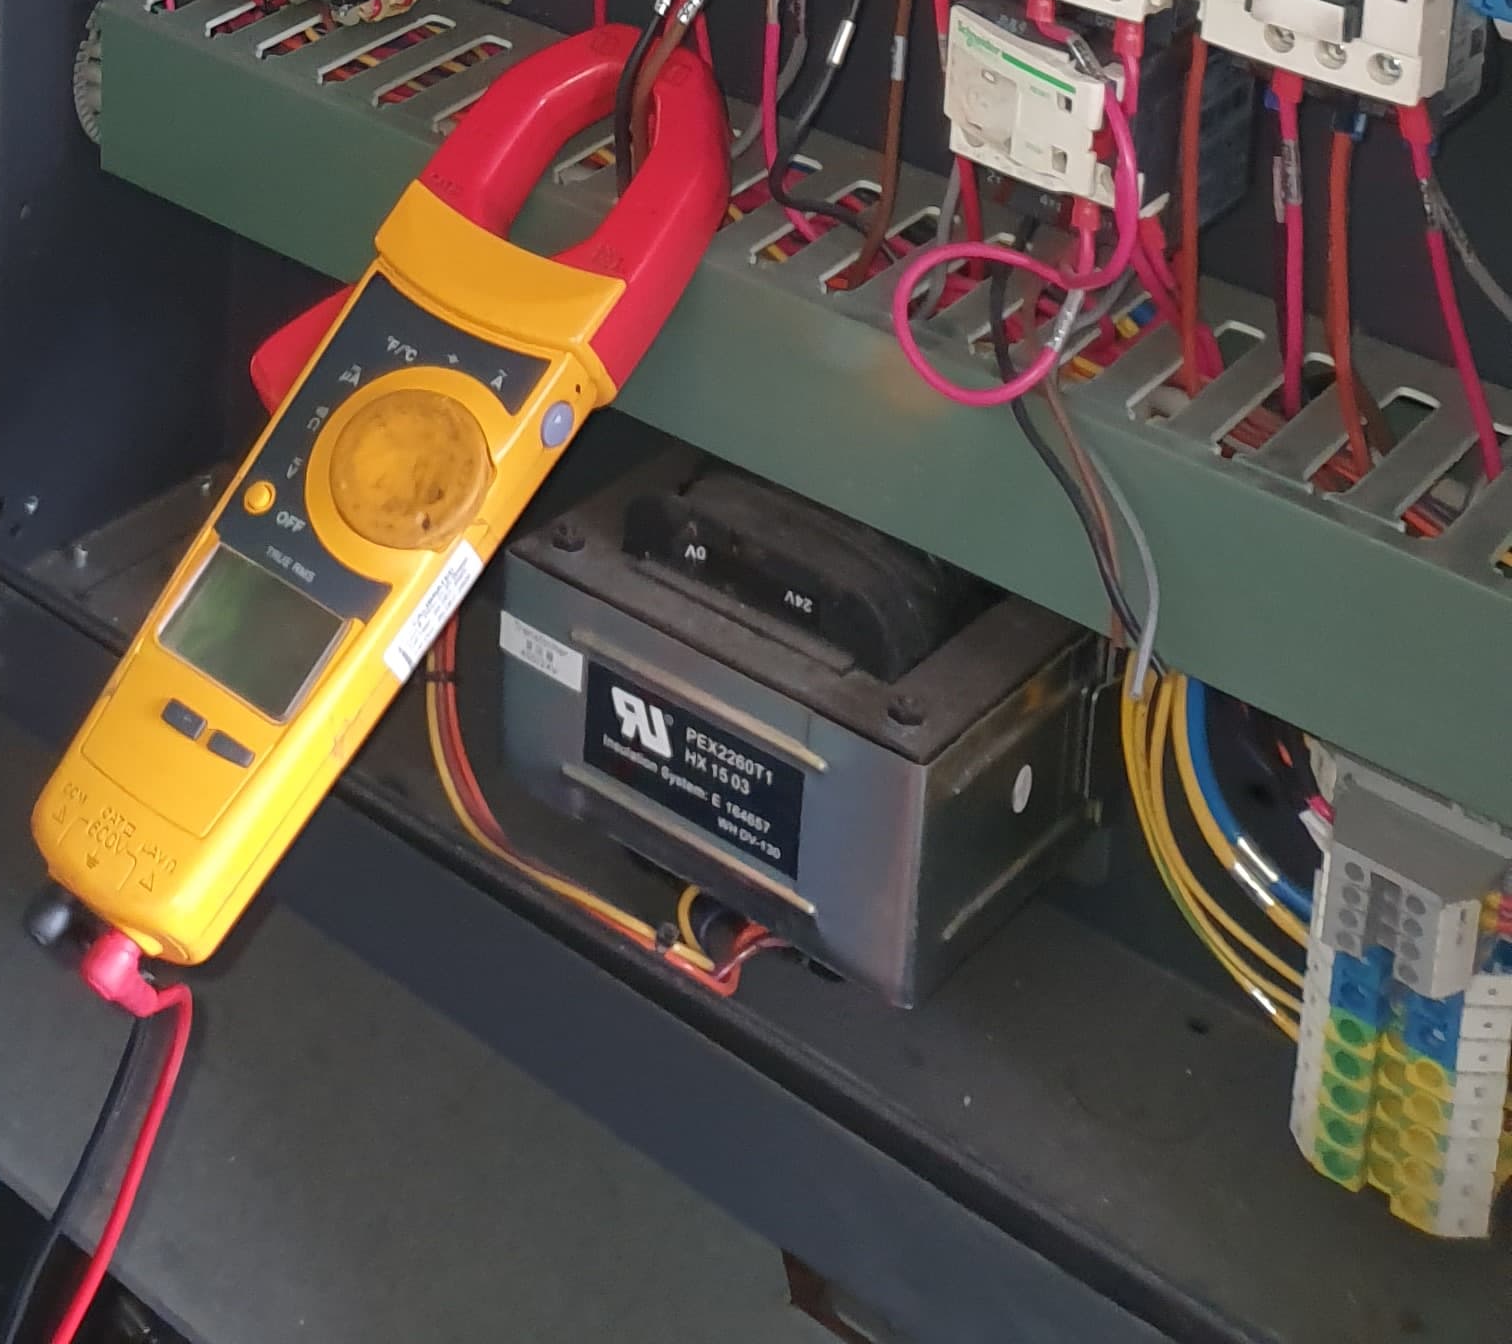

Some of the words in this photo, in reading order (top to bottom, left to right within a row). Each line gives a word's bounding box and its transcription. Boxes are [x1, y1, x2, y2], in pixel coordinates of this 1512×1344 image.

[276, 510, 307, 533] OFF
[265, 545, 293, 568] TRUE
[291, 560, 317, 583] RMS
[783, 589, 814, 614] 24V
[602, 732, 659, 774] Insulation
[710, 792, 722, 809] E
[684, 747, 708, 773] HX
